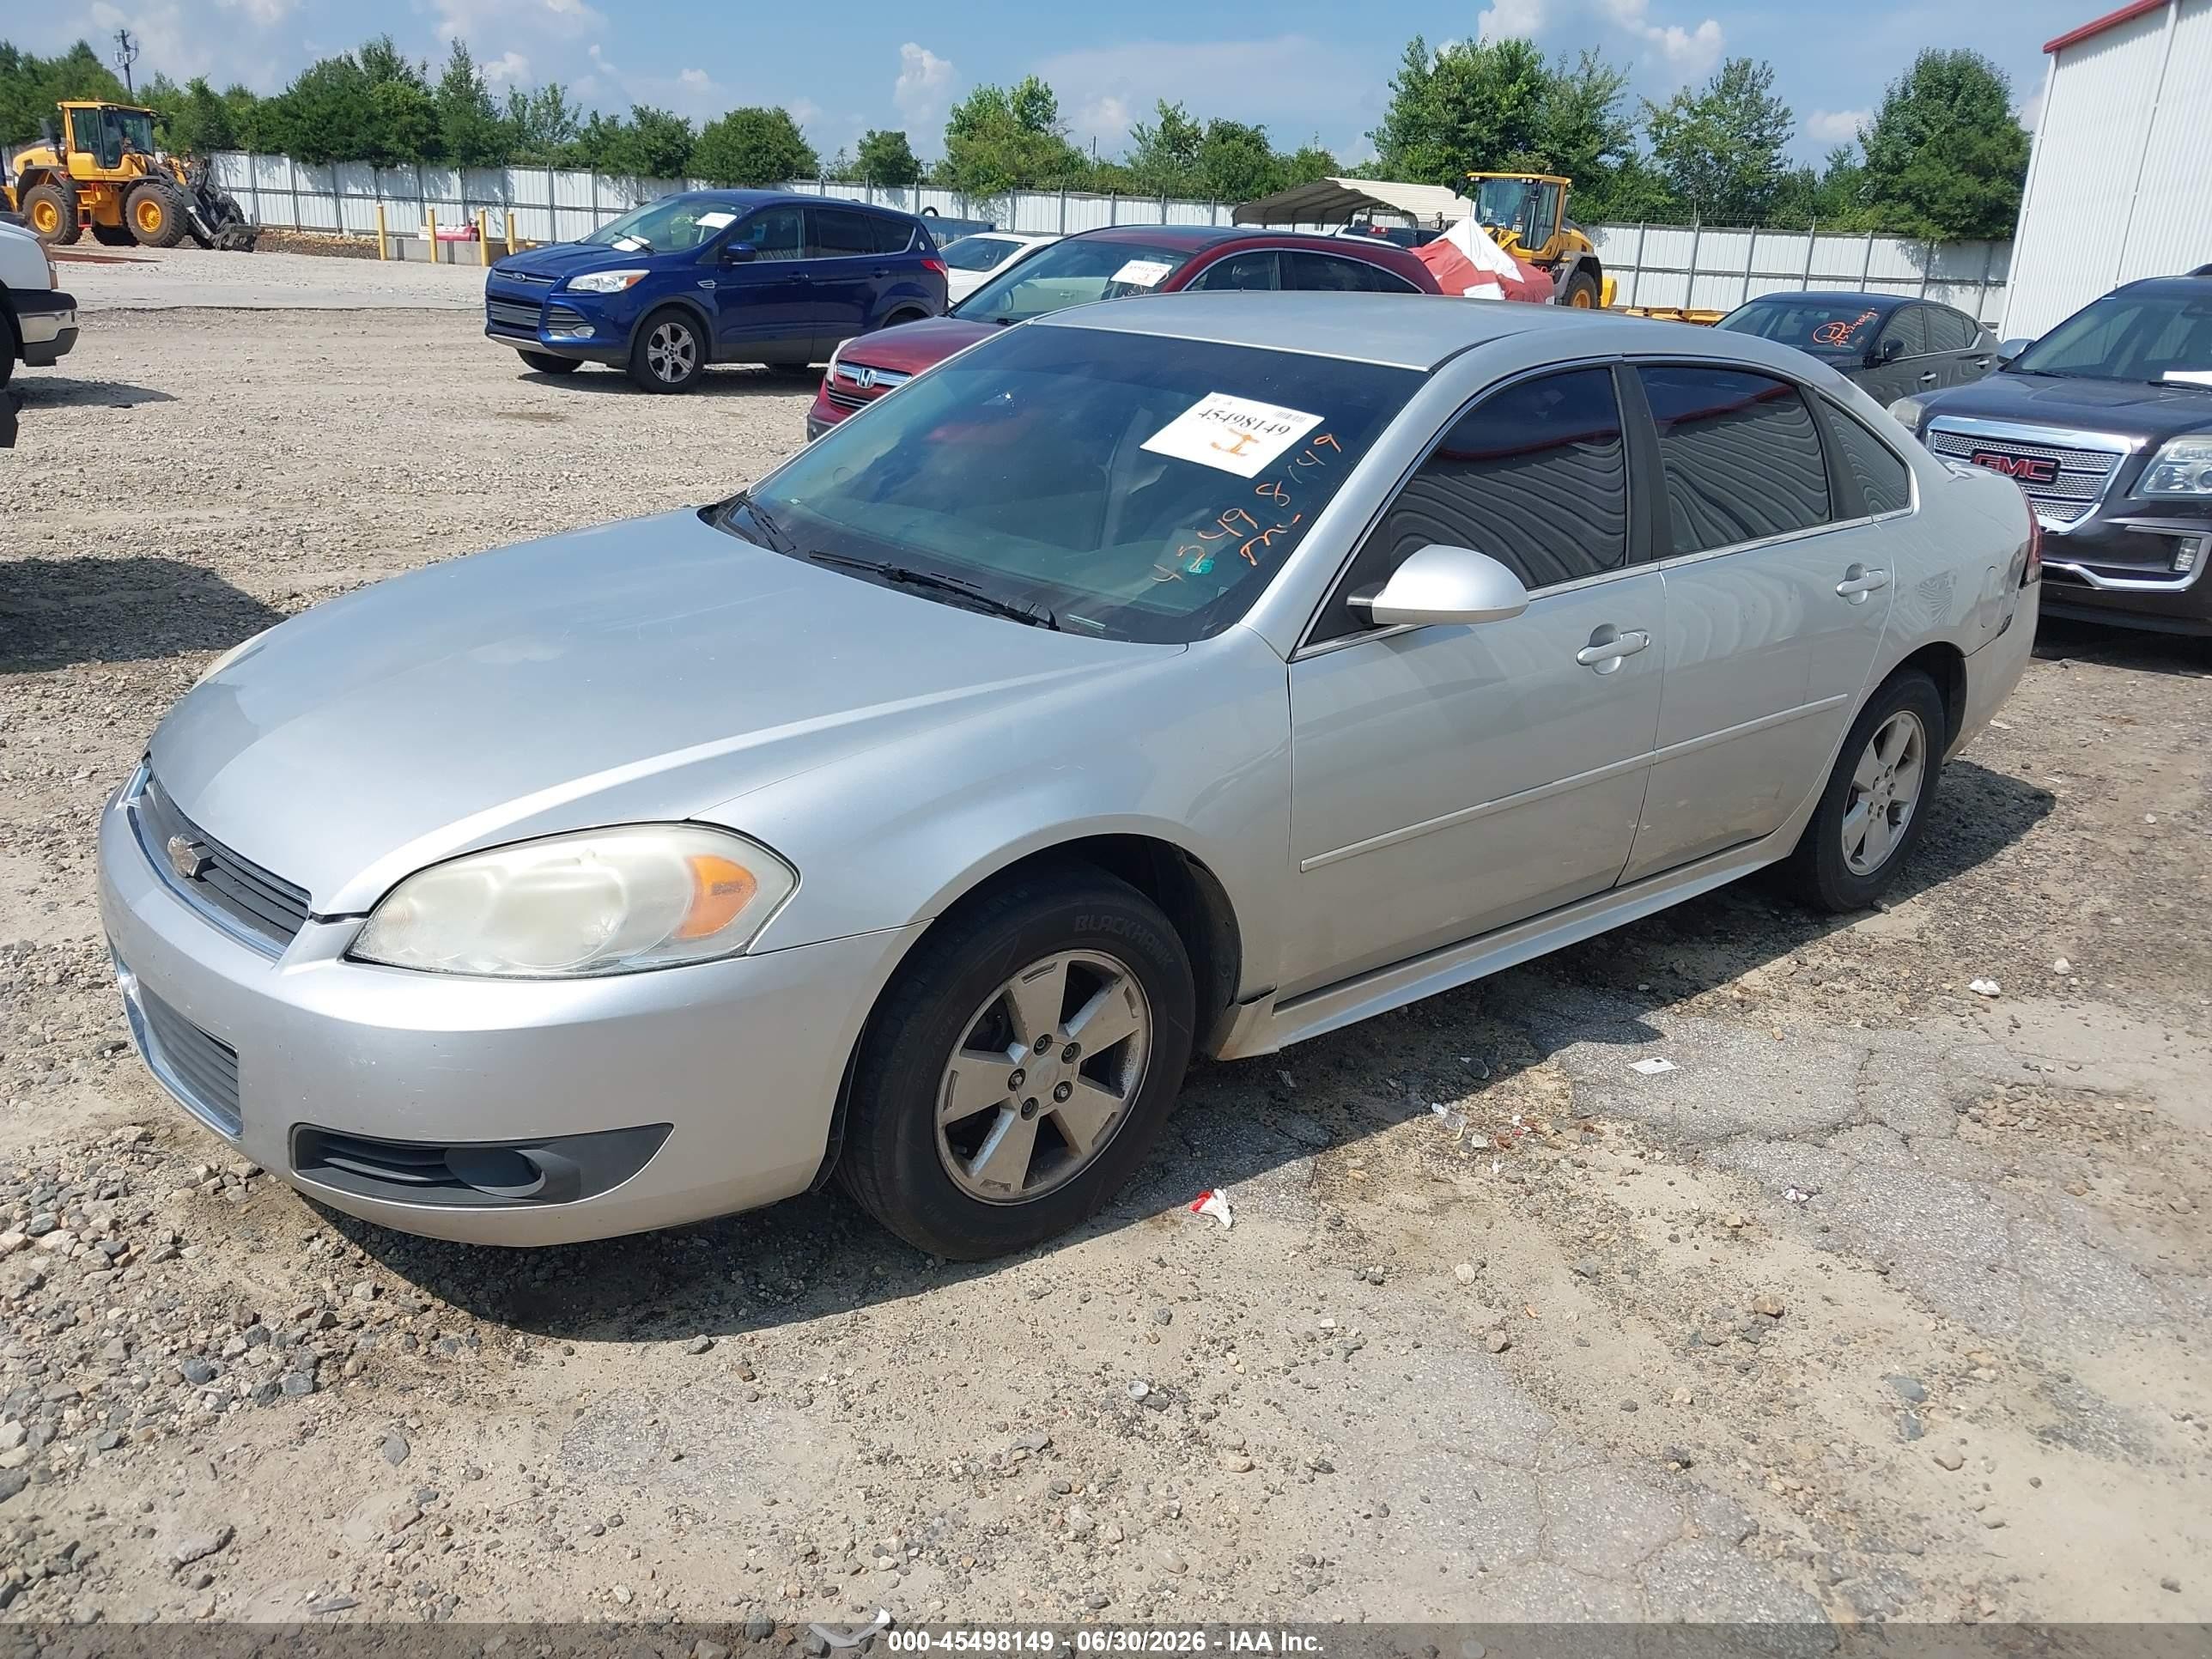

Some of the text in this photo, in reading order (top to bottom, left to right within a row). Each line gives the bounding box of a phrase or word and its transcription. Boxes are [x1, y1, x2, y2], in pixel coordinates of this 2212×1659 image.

[1198, 407, 1291, 436] 45498149
[1972, 453, 2056, 481] GMC
[1074, 914, 1176, 970] BLACKHAWK
